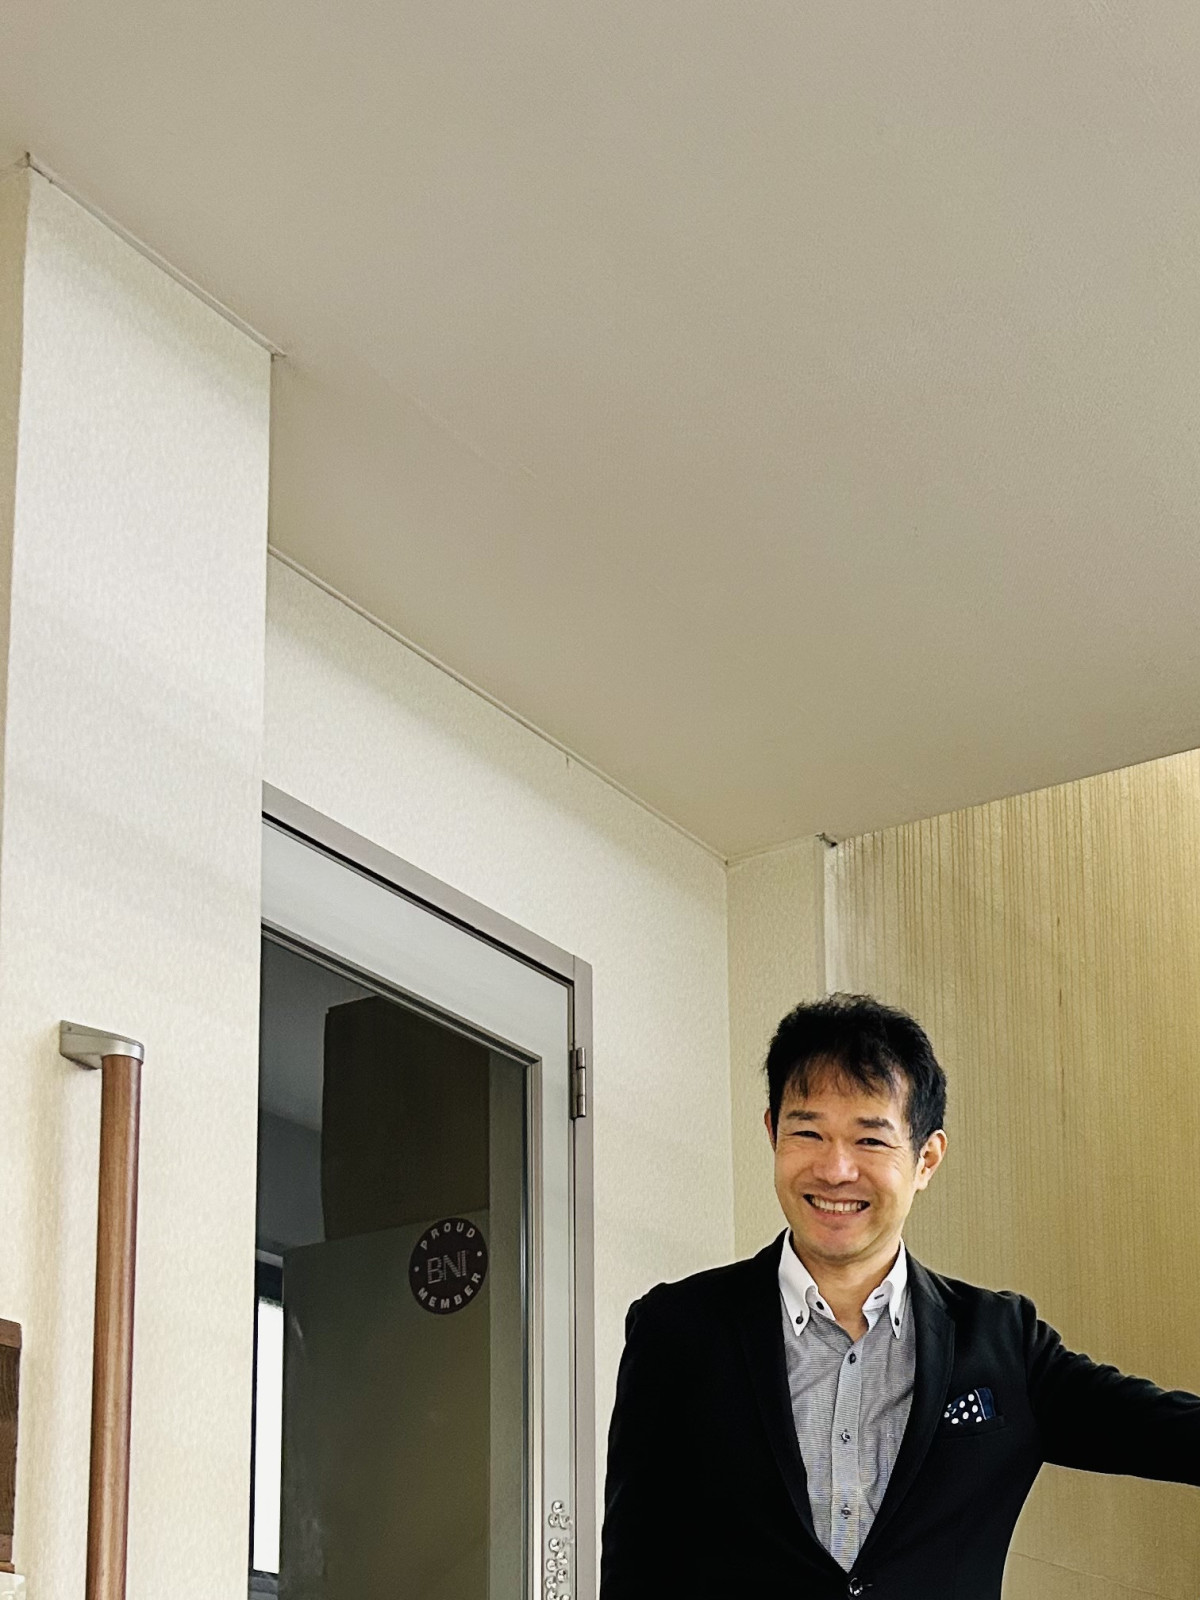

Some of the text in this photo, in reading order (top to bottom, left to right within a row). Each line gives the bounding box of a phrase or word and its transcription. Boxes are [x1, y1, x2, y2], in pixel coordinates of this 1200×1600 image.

[420, 1222, 476, 1250] PROUD
[427, 1250, 467, 1284] BNI
[418, 1272, 481, 1309] MEMBER
